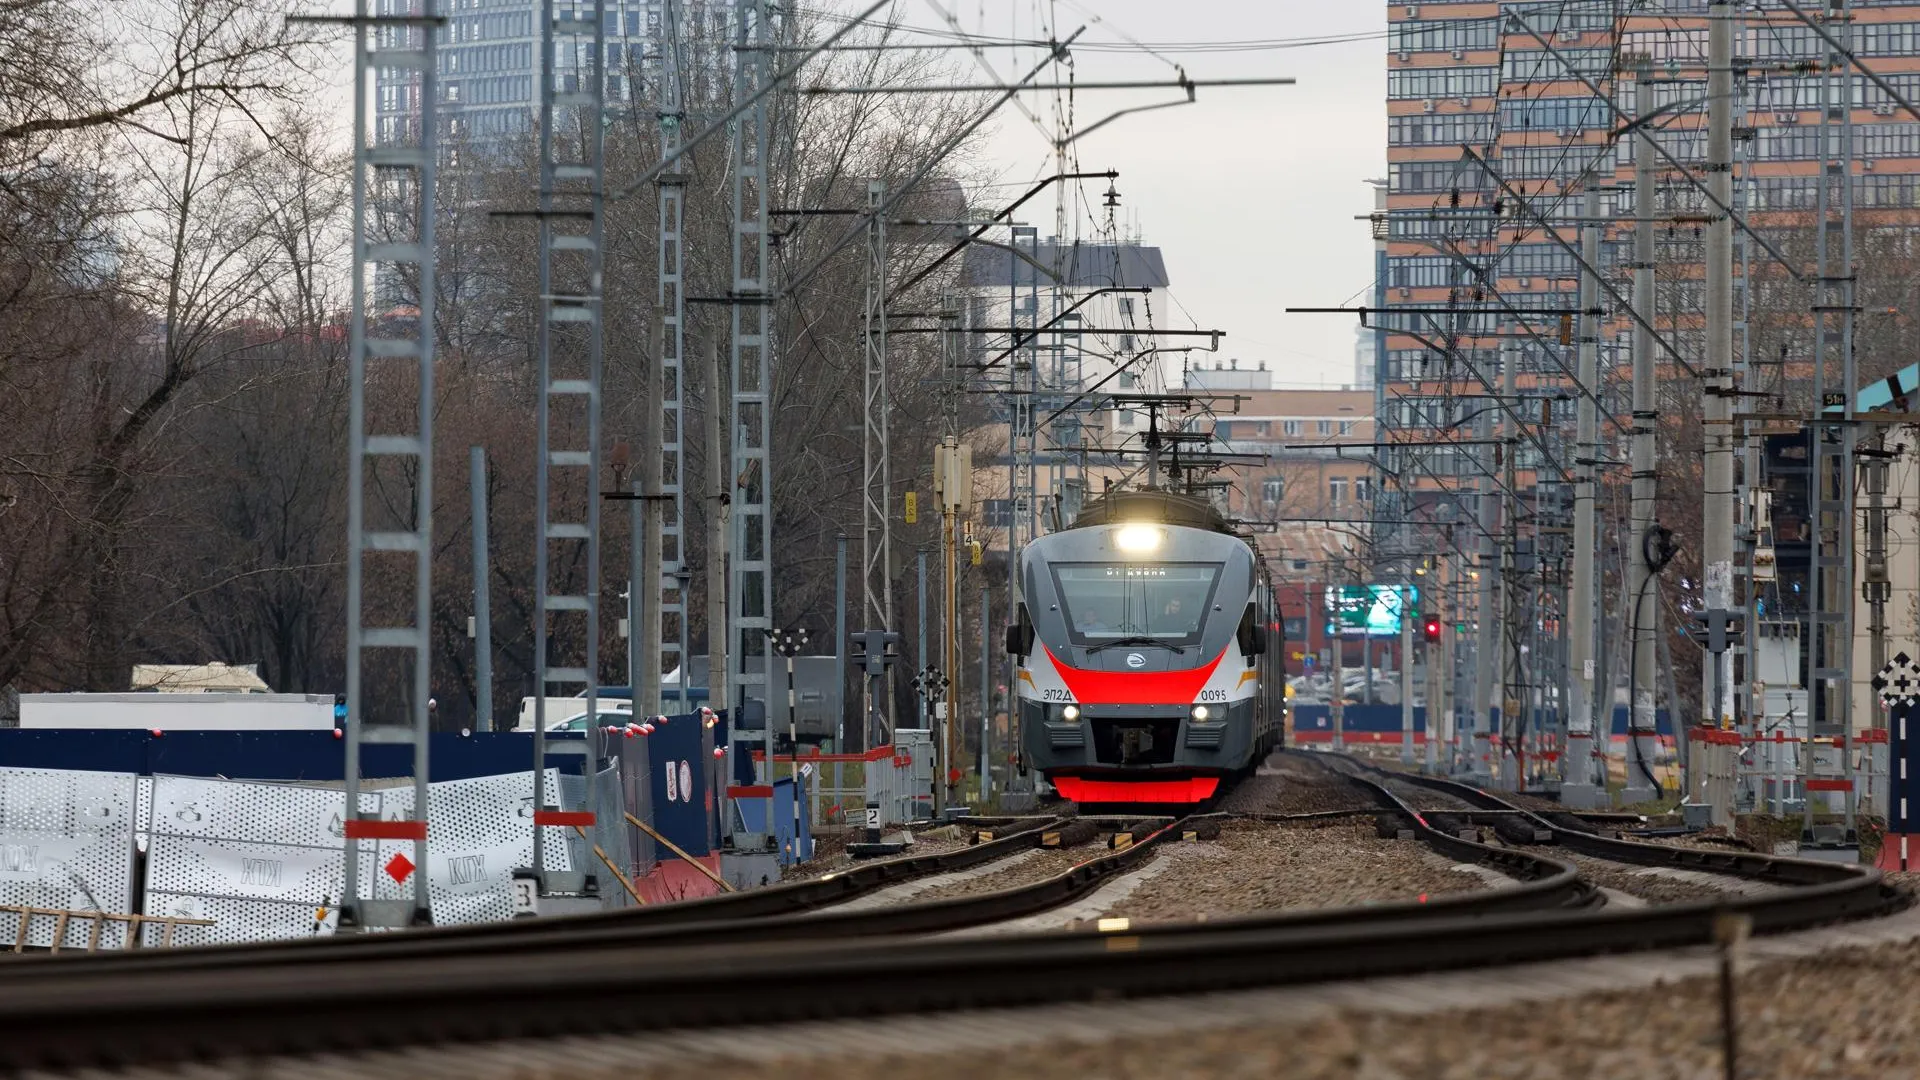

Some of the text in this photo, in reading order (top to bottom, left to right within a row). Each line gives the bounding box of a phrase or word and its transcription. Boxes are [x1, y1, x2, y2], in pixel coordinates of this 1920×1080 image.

[965, 535, 972, 545] 4
[1043, 689, 1072, 702] ЭП2Д
[1201, 689, 1227, 701] 0095
[868, 810, 878, 824] 2
[517, 884, 531, 907] 3
